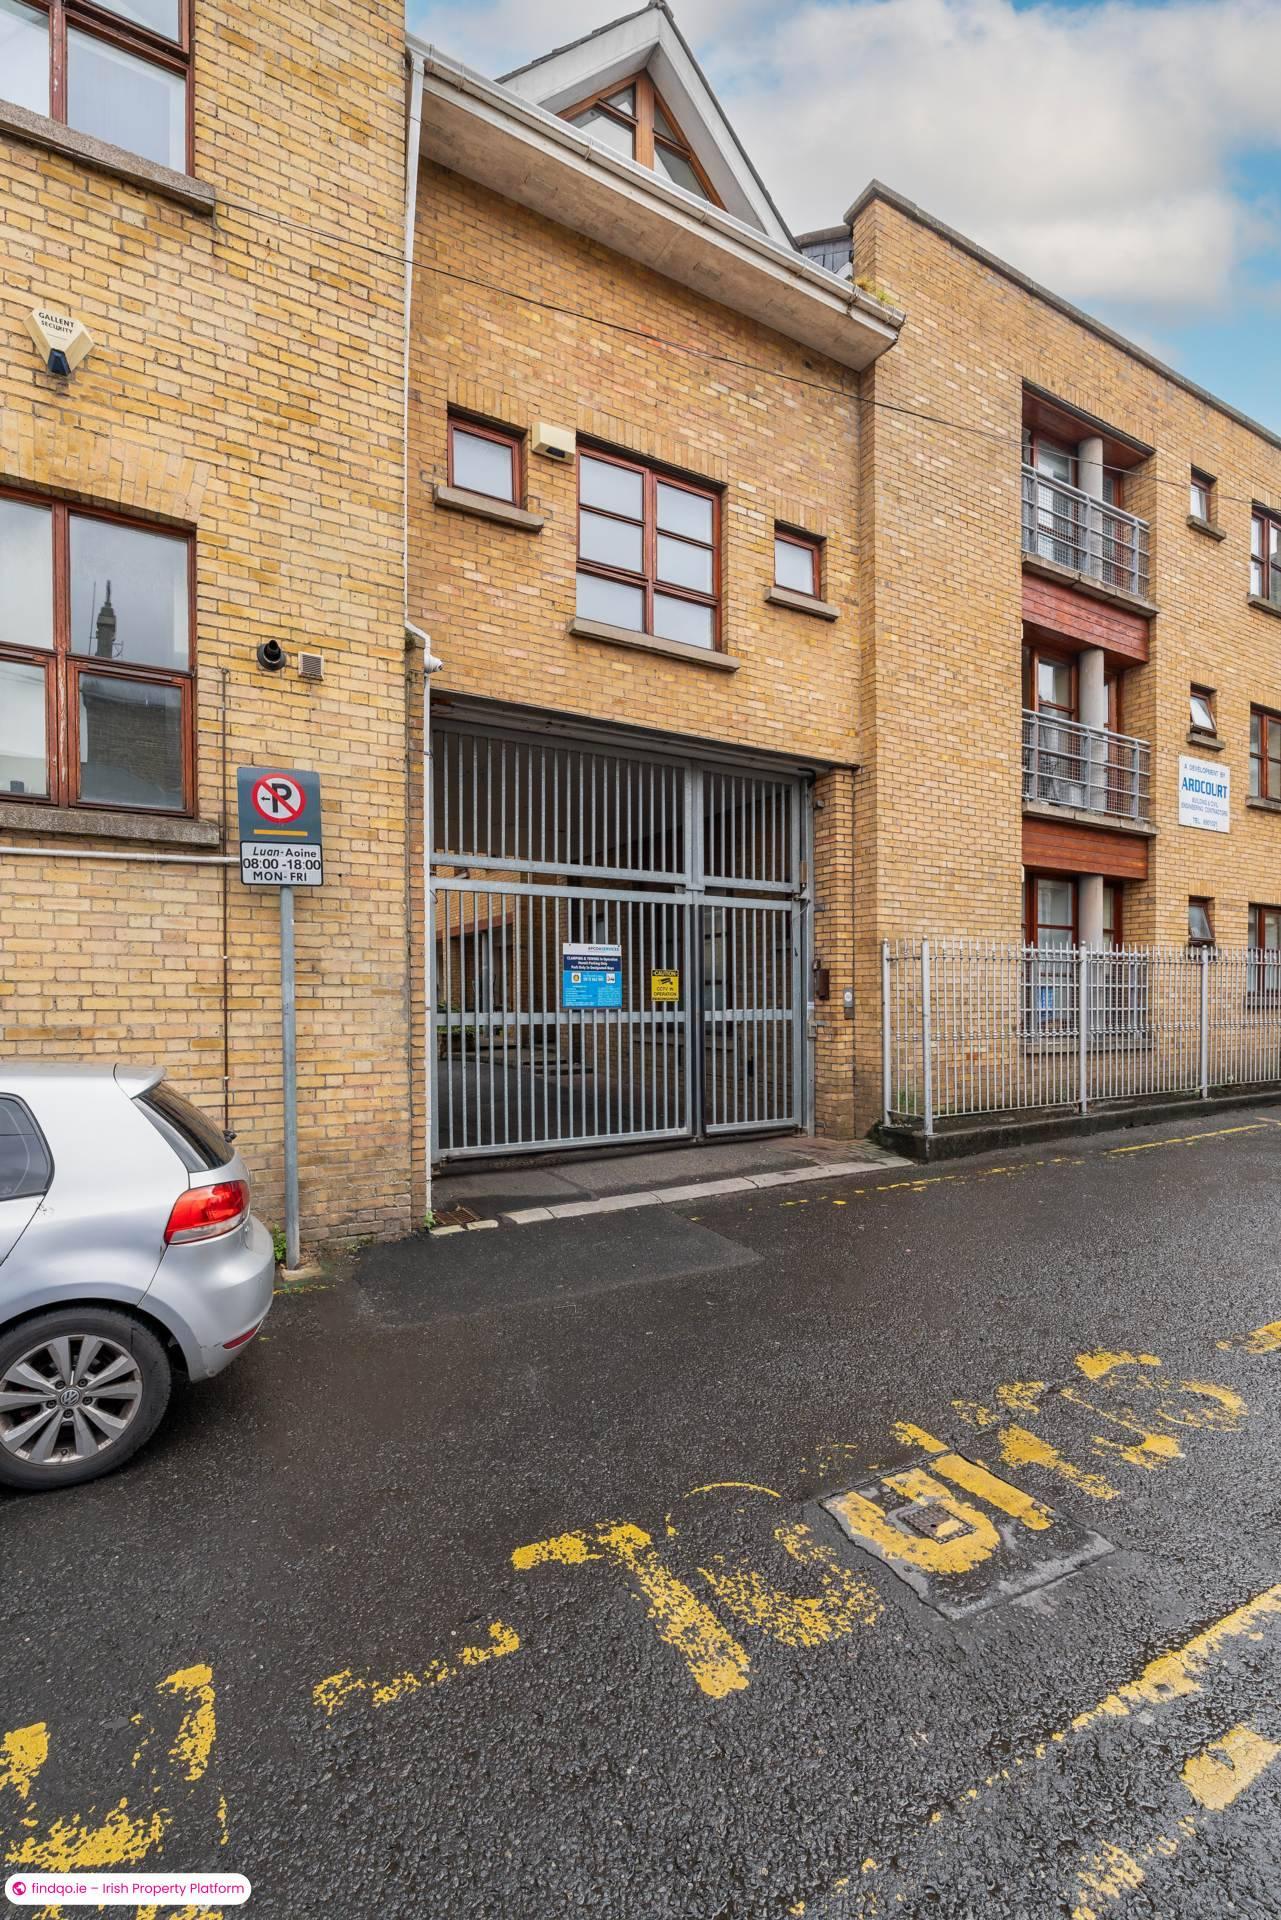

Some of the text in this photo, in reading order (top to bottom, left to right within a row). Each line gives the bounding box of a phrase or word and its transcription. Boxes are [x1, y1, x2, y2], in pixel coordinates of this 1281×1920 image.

[38, 312, 75, 328] GALLENT
[41, 320, 73, 334] SECURITY
[1189, 764, 1218, 776] DEVELOPMENT
[1181, 776, 1228, 799] ARDCOURT
